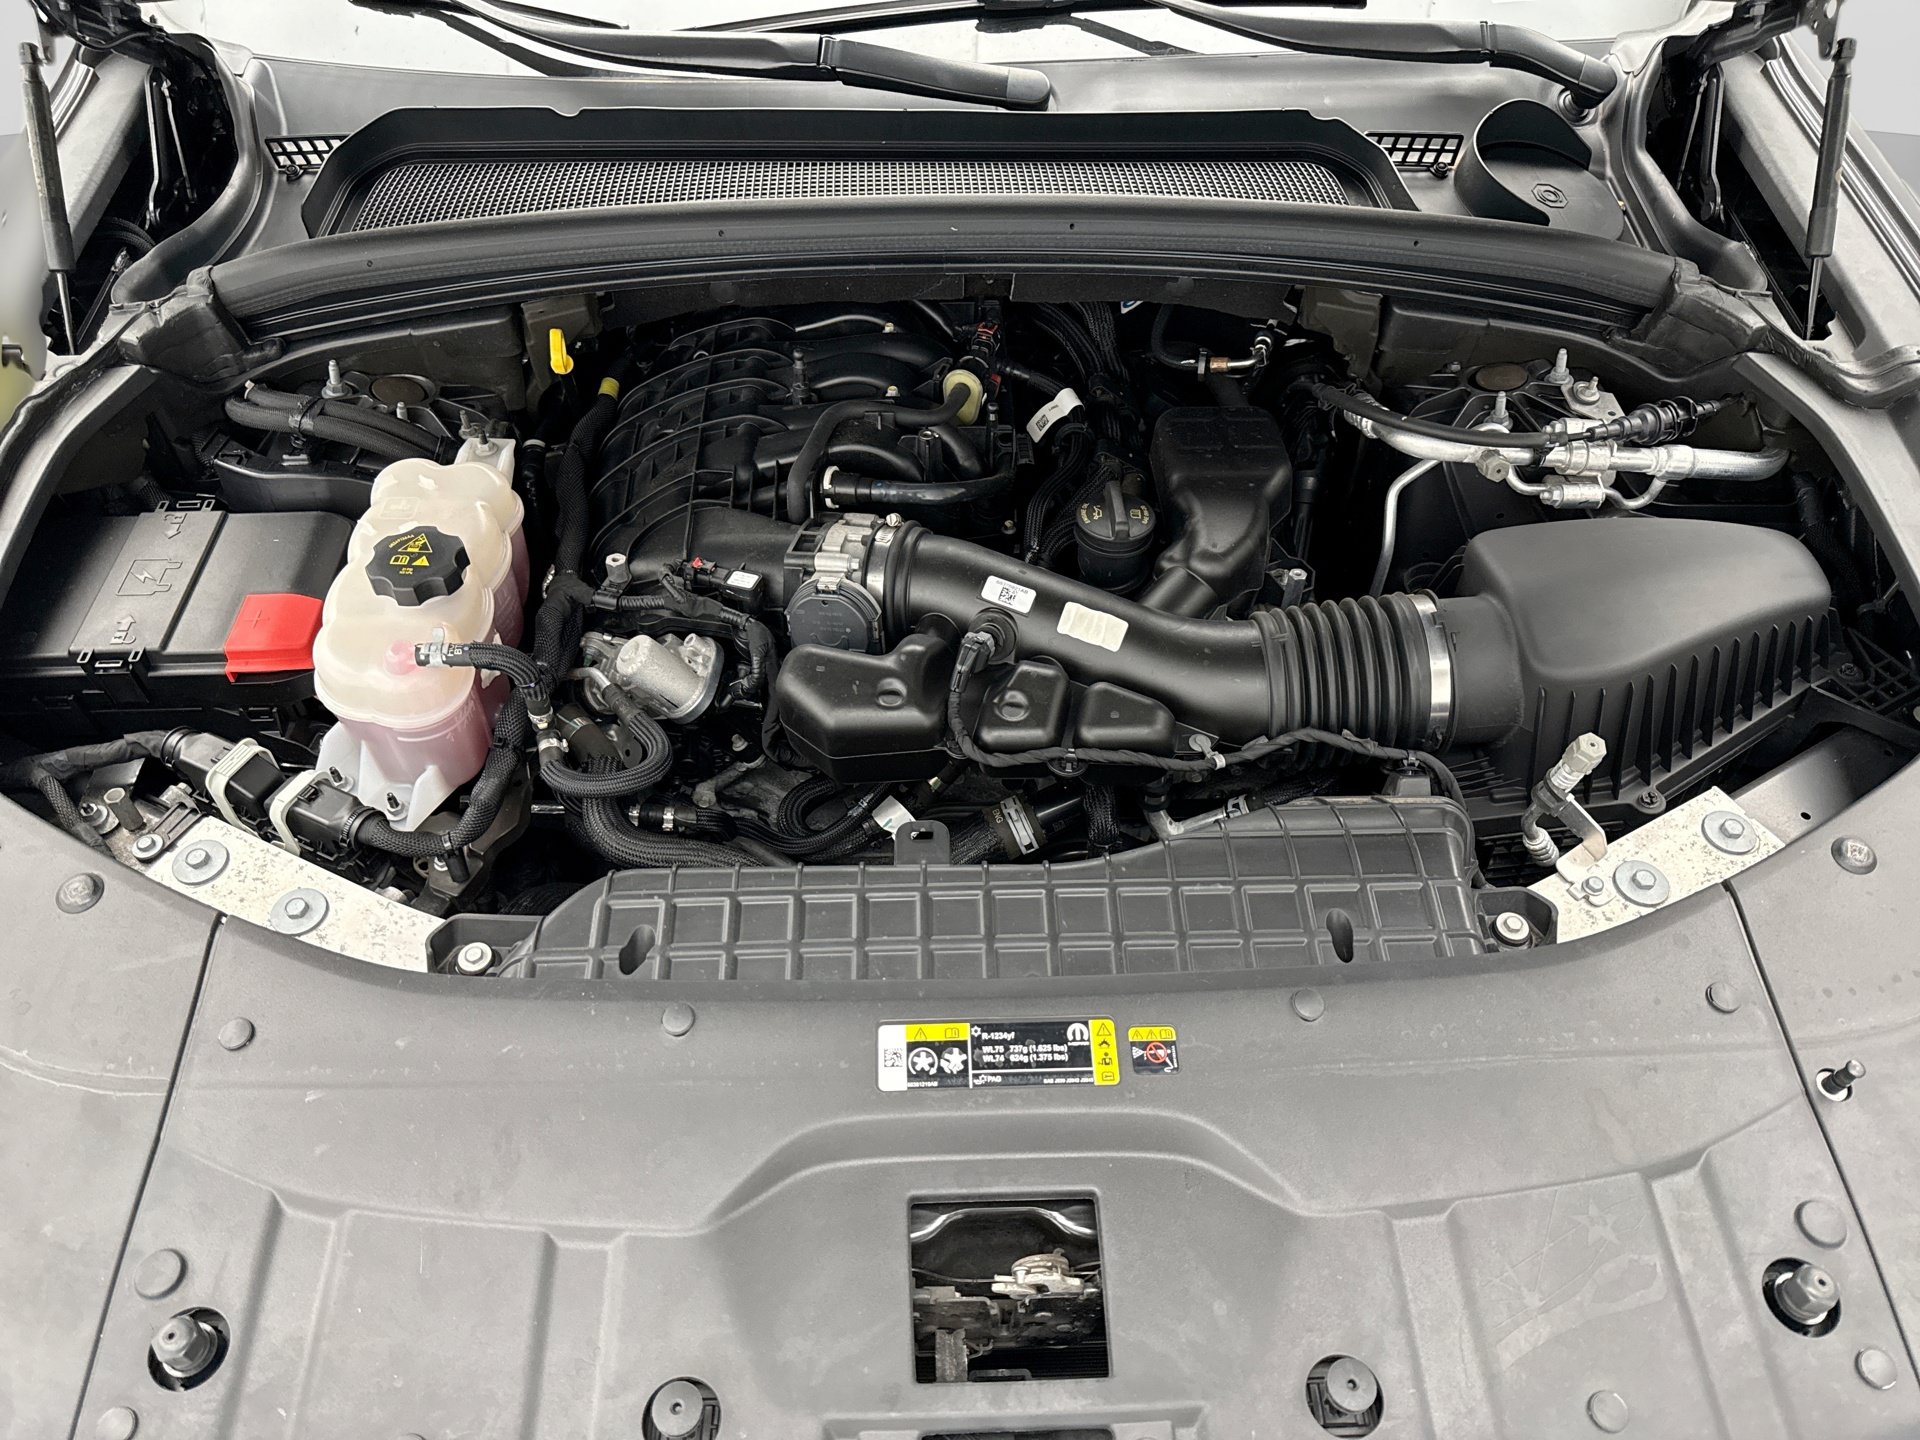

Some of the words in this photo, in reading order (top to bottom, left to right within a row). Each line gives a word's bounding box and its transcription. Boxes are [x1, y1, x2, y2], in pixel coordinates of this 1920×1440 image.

[992, 808, 1004, 824] ENG
[981, 1031, 1016, 1041] R-1234yf
[981, 1045, 1005, 1054] WL75
[1009, 1044, 1028, 1054] 737g
[1029, 1043, 1052, 1053] (1.625
[1052, 1043, 1068, 1053] lbs)
[982, 1054, 1005, 1063] WL74
[1009, 1053, 1029, 1063] 624g
[1029, 1052, 1053, 1062] (1.375
[1053, 1052, 1068, 1062] lbs)
